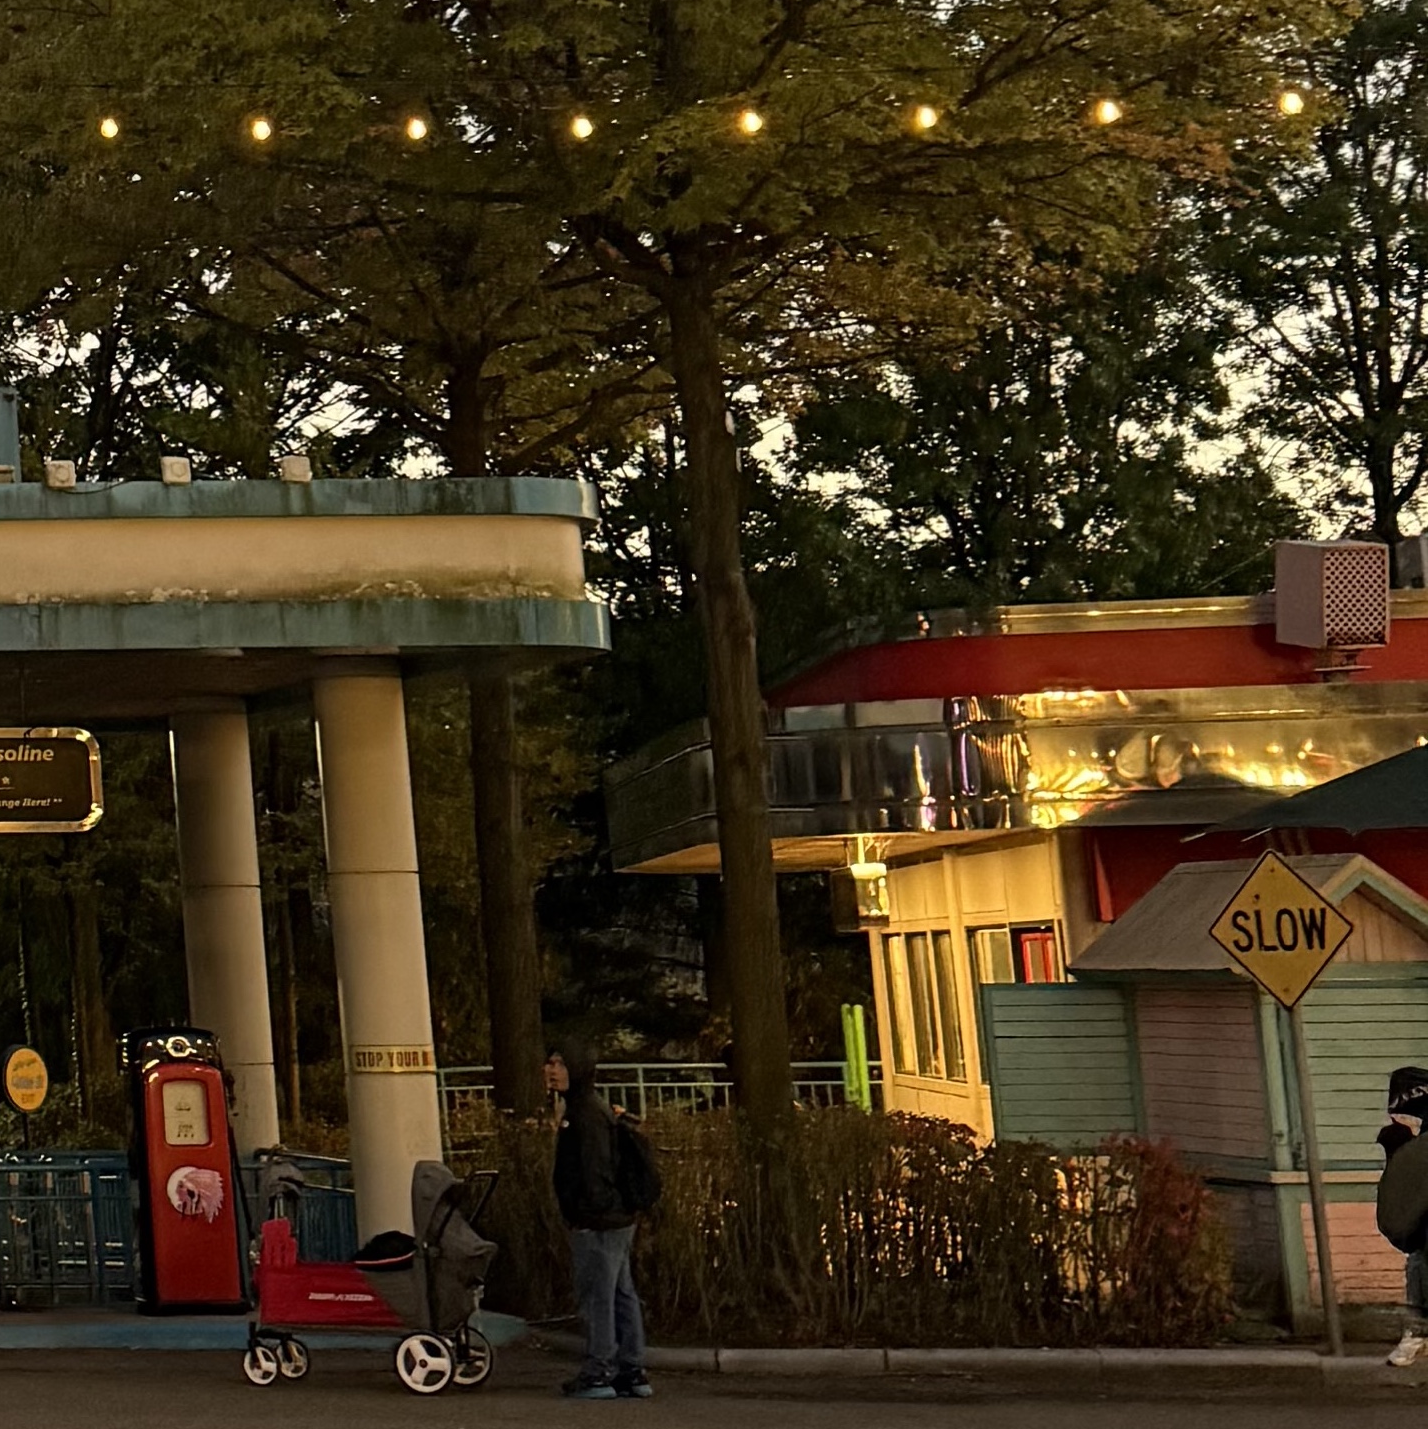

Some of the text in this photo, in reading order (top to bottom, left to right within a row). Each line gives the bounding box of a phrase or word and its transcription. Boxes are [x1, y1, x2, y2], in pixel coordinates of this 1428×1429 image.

[23, 797, 51, 807] Here!
[1231, 907, 1327, 953] SLOW
[355, 1050, 384, 1068] STOP
[387, 1050, 420, 1068] YOUR
